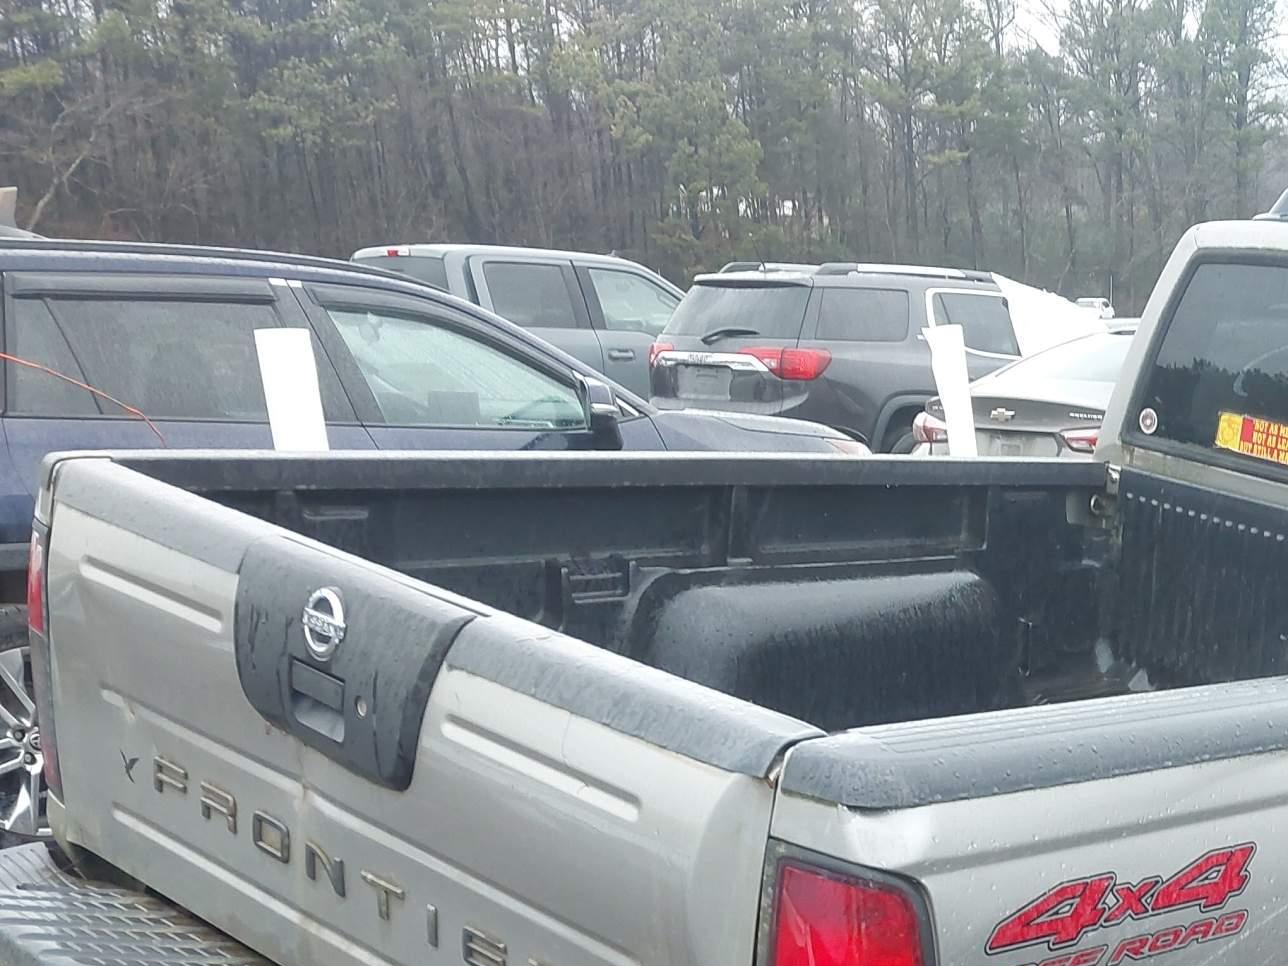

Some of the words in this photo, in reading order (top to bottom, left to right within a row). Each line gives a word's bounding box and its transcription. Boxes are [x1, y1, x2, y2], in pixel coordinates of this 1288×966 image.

[1254, 420, 1269, 433] NOT
[1269, 423, 1279, 435] AS
[1252, 432, 1267, 446] NOT
[1267, 435, 1277, 448] AS
[1239, 441, 1253, 454] BUT
[1253, 444, 1271, 460] STILL
